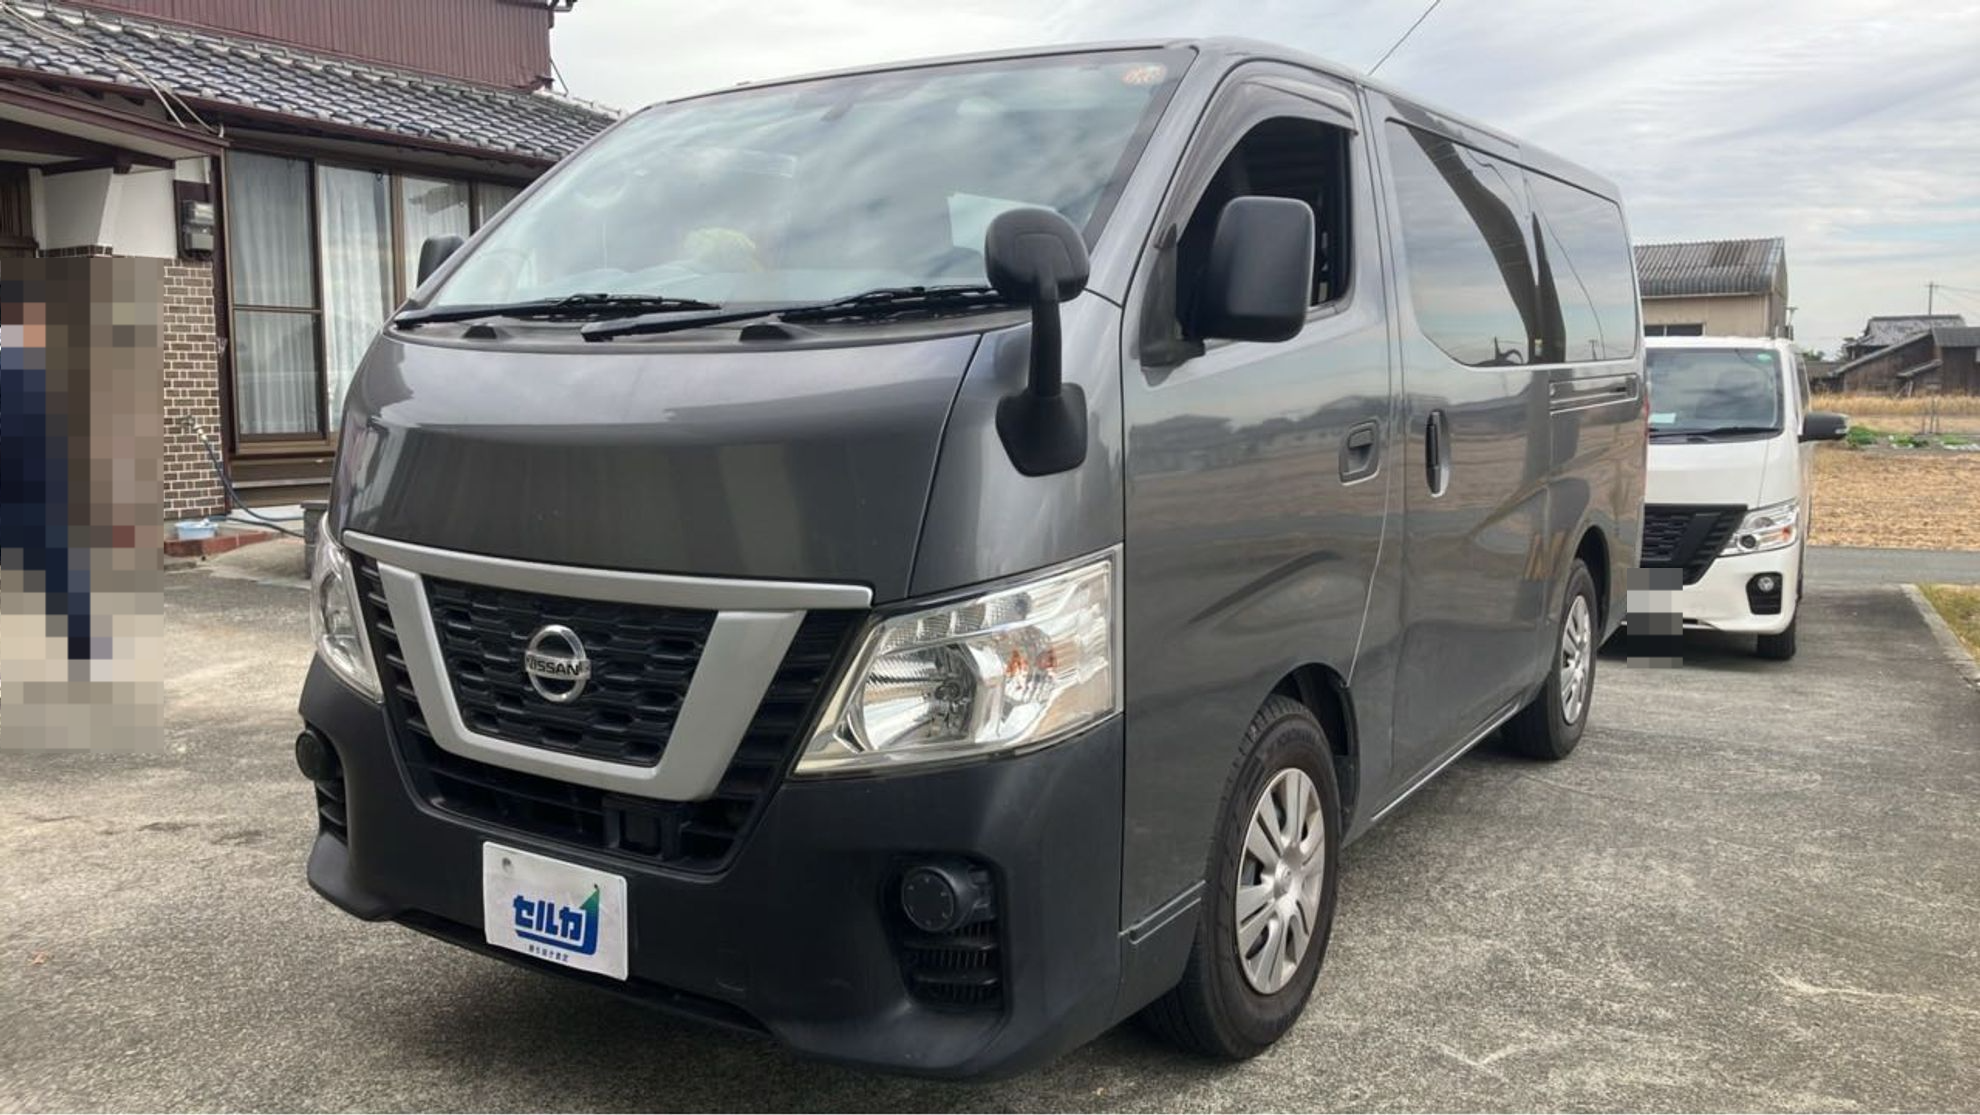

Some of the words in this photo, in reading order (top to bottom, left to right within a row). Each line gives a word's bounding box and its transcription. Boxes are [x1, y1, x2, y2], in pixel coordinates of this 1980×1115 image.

[526, 655, 583, 676] NISSAN
[513, 895, 583, 941] セルカ
